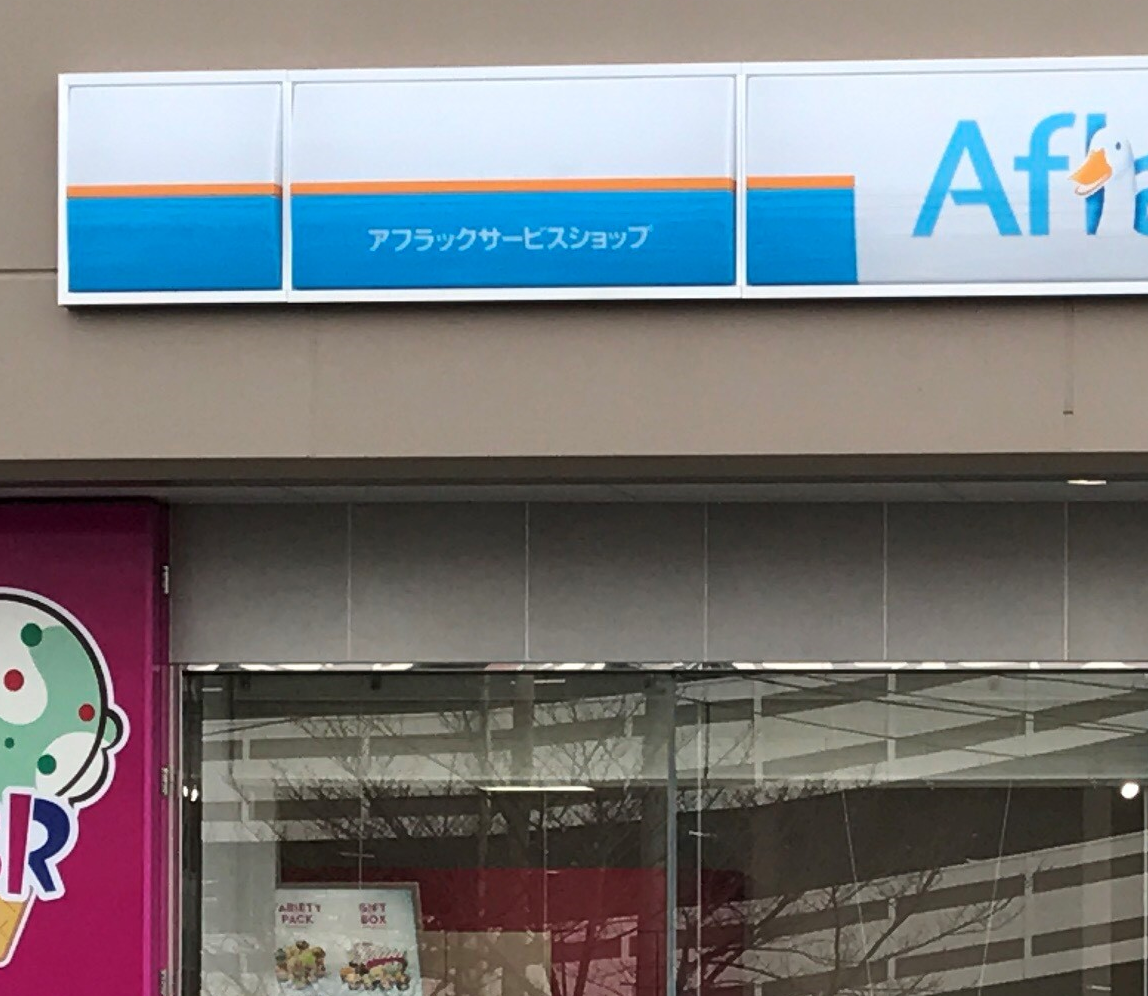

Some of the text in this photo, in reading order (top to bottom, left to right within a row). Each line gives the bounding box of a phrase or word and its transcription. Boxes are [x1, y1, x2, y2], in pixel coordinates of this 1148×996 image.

[367, 224, 654, 252] アフラックサービスショップ
[281, 914, 314, 925] PACK
[360, 914, 387, 925] BOX
